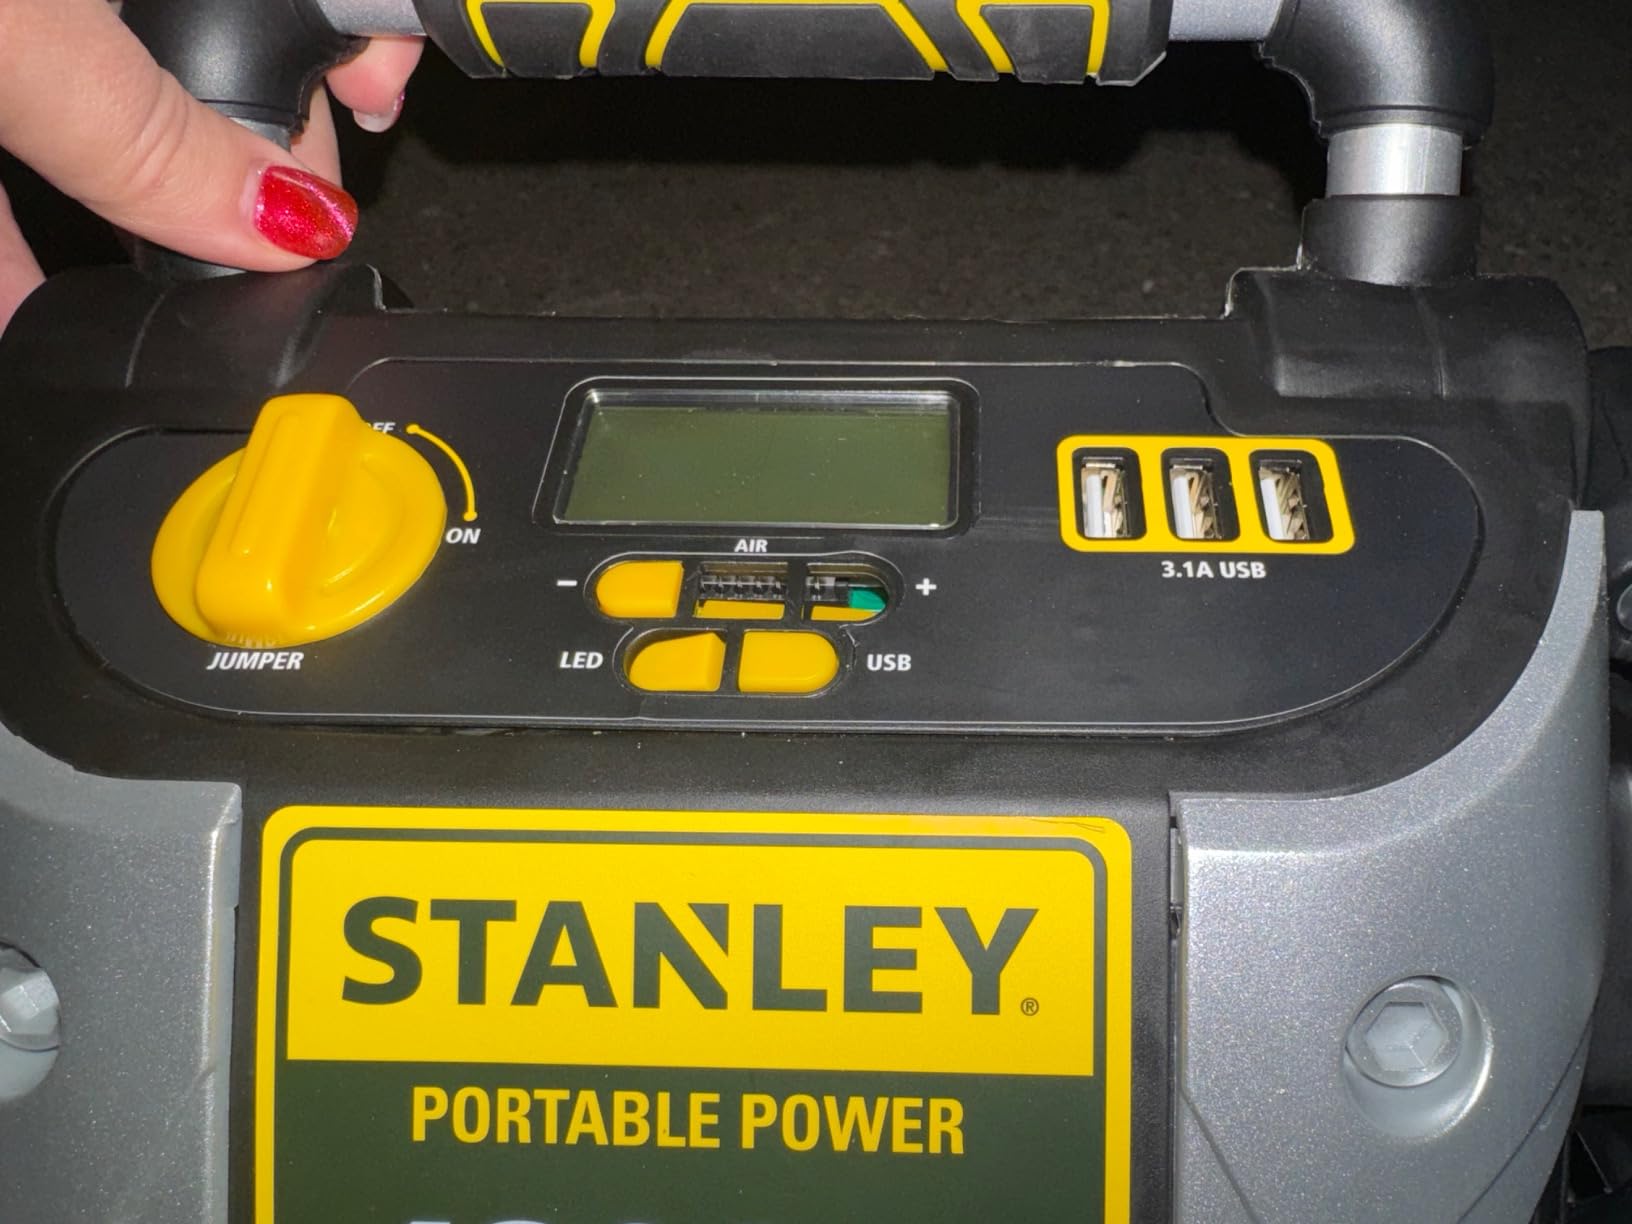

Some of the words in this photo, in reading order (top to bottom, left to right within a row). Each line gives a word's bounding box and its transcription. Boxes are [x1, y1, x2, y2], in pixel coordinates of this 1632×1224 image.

[445, 527, 482, 545] ON
[734, 538, 769, 553] AIR
[1160, 560, 1215, 579] 3.1A
[1219, 560, 1267, 580] USB
[205, 650, 305, 671] JUMPER
[559, 650, 604, 670] LED
[866, 653, 912, 672] USB
[411, 1086, 721, 1149] PORTABLE
[741, 1093, 965, 1156] POWER
